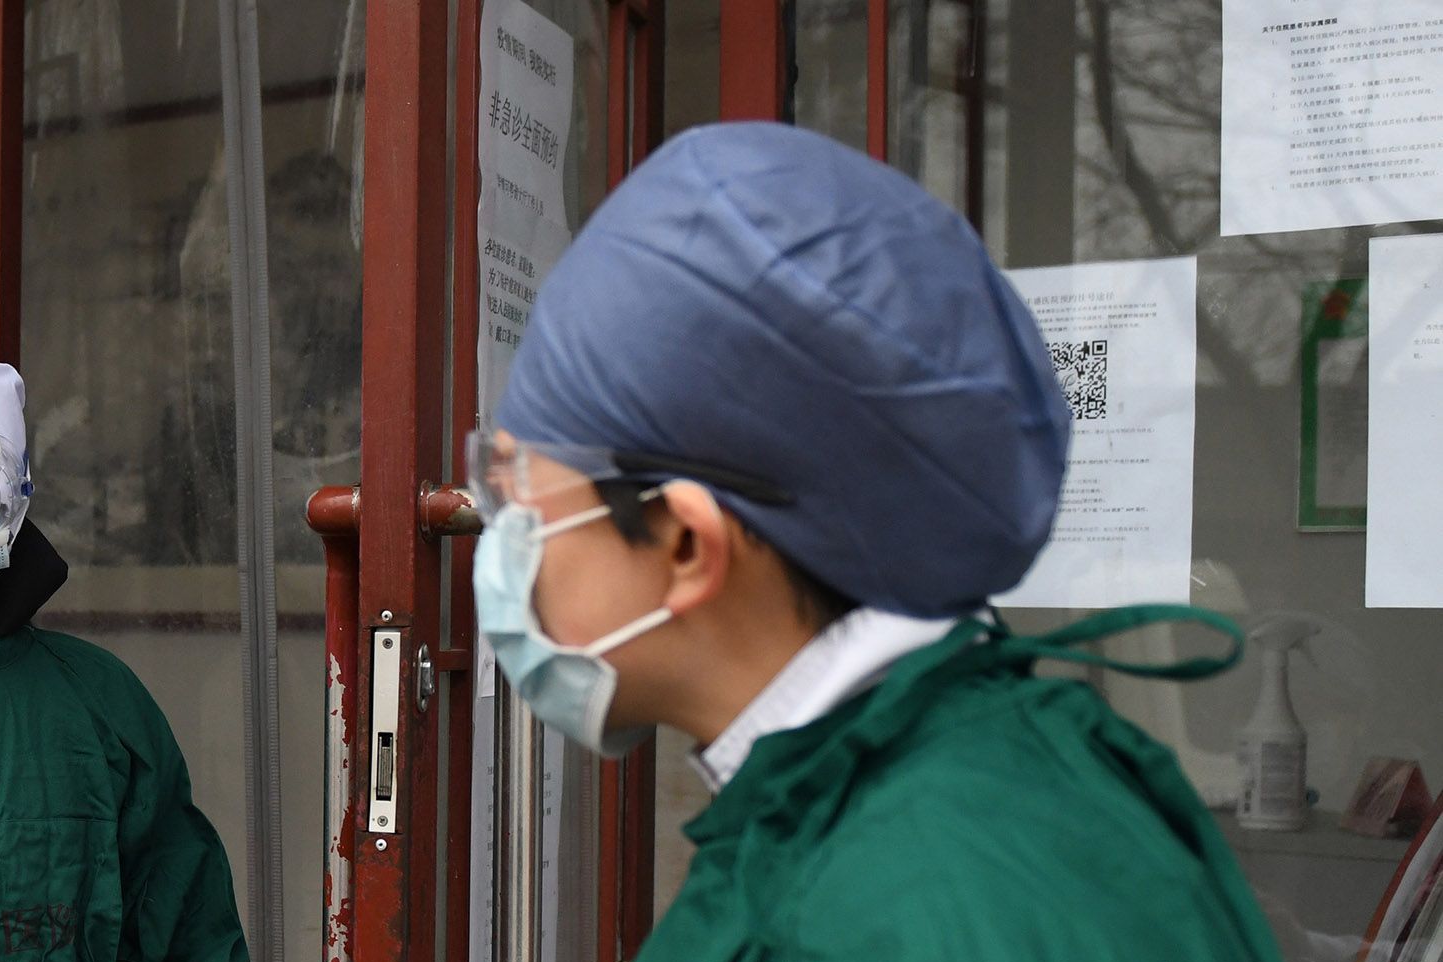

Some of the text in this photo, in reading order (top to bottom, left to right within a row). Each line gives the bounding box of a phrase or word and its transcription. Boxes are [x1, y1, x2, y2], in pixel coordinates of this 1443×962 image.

[488, 88, 559, 172] 非急诊全面预约
